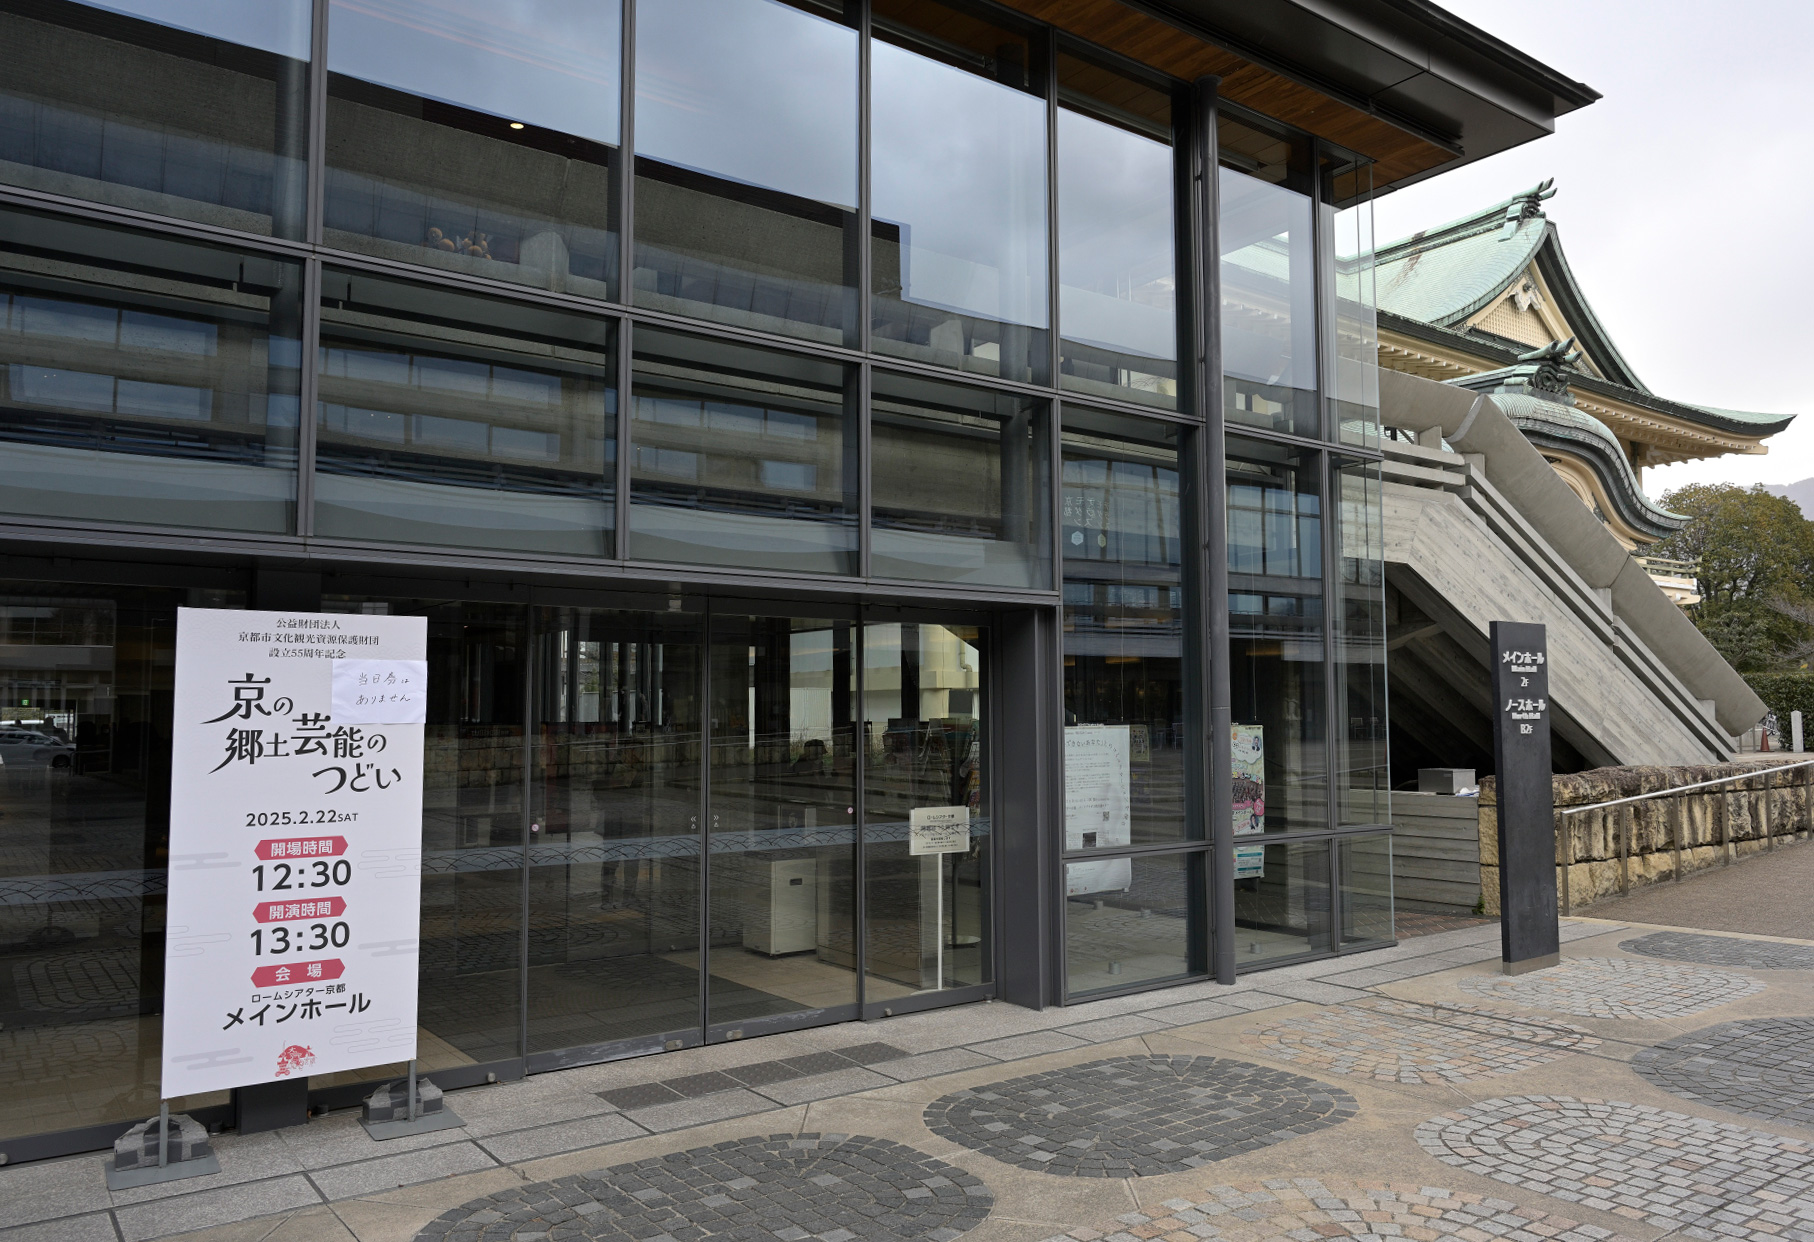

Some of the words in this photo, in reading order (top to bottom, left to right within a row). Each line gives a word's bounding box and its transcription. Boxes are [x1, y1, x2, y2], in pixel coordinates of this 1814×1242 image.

[276, 618, 340, 630] 公益財団法人
[238, 631, 379, 645] 京都市文化観光資源保護財団
[268, 647, 346, 659] 設立55周年記念
[1502, 651, 1544, 664] メインホール
[1520, 677, 1529, 687] 2F
[200, 672, 294, 725] 京の
[355, 694, 411, 706] ありません
[1505, 699, 1546, 711] ノースホール
[1520, 724, 1533, 734] B2F
[207, 712, 387, 775] 郷土芸能の
[312, 762, 402, 795] つどい
[270, 840, 333, 857] 開場時間
[252, 859, 351, 892] 12:30
[269, 901, 331, 920] 開演時間
[250, 921, 350, 956] 13:30
[252, 983, 346, 1003] ロームシアター京都
[222, 992, 371, 1031] メインホール
